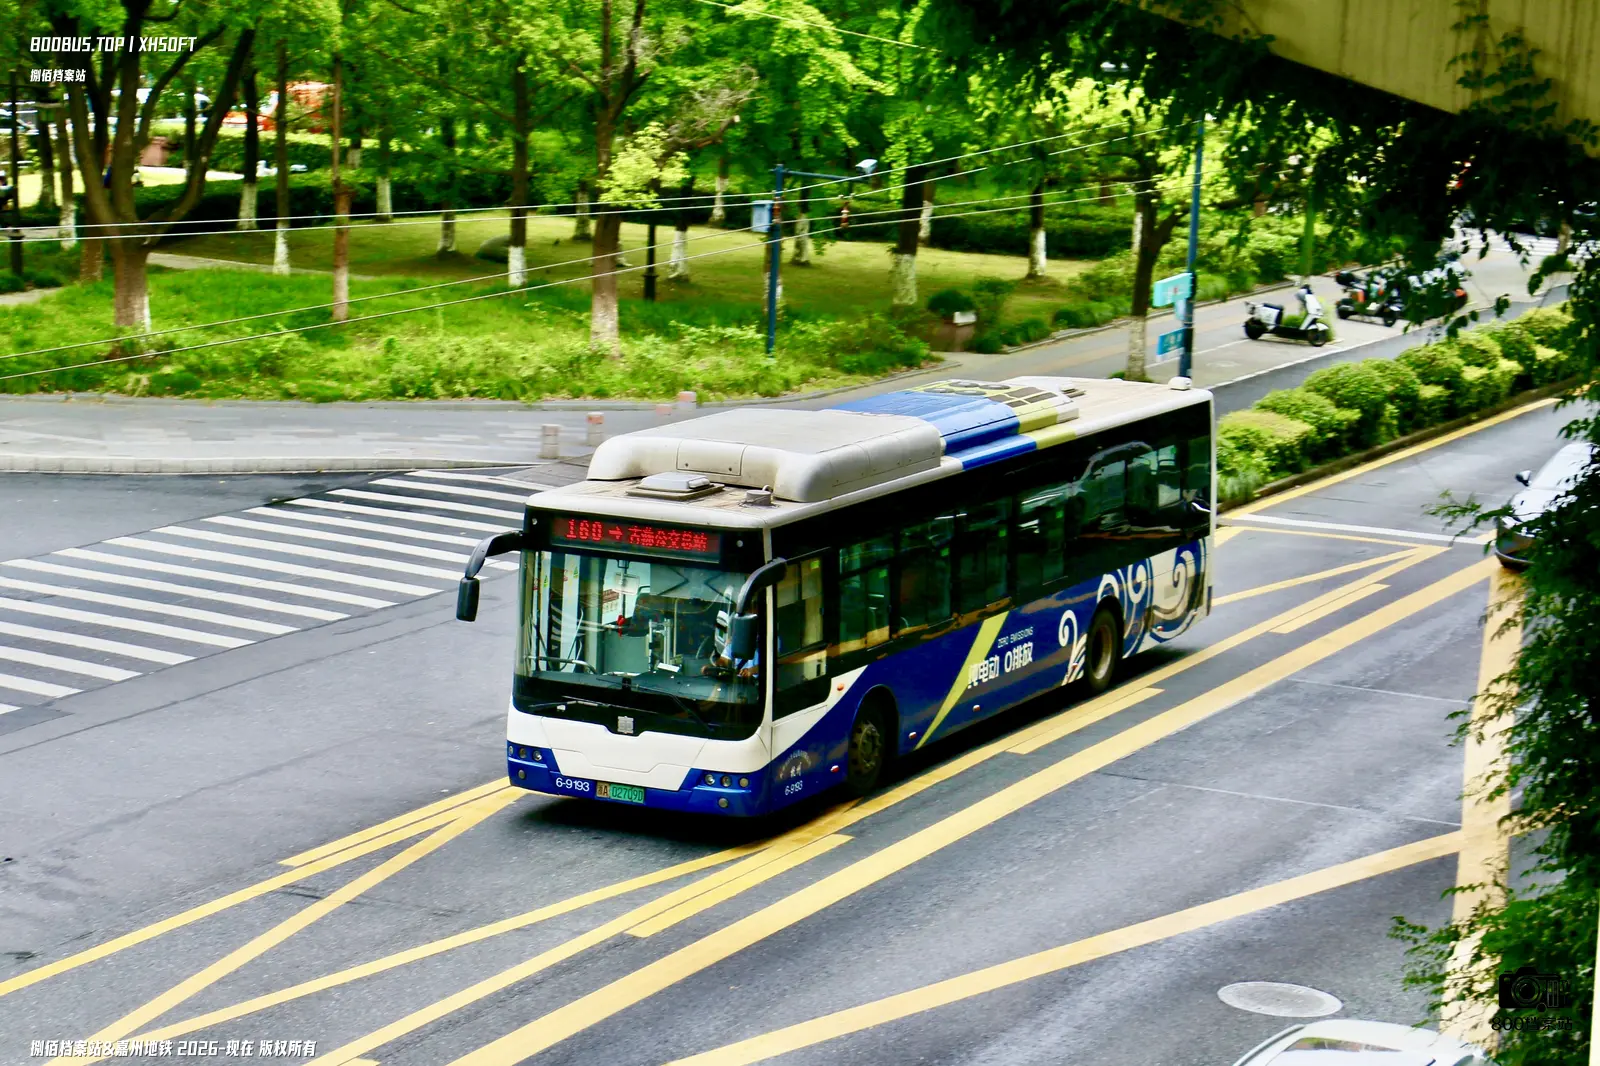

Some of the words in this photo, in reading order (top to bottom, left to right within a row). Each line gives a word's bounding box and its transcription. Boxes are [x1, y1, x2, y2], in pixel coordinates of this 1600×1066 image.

[566, 519, 604, 541] 160
[998, 637, 1008, 648] ZERO
[1010, 627, 1033, 643] EMISSIONS
[967, 655, 1000, 689] 纯电动
[555, 777, 590, 792] 6-9193
[784, 780, 804, 796] 6-9193
